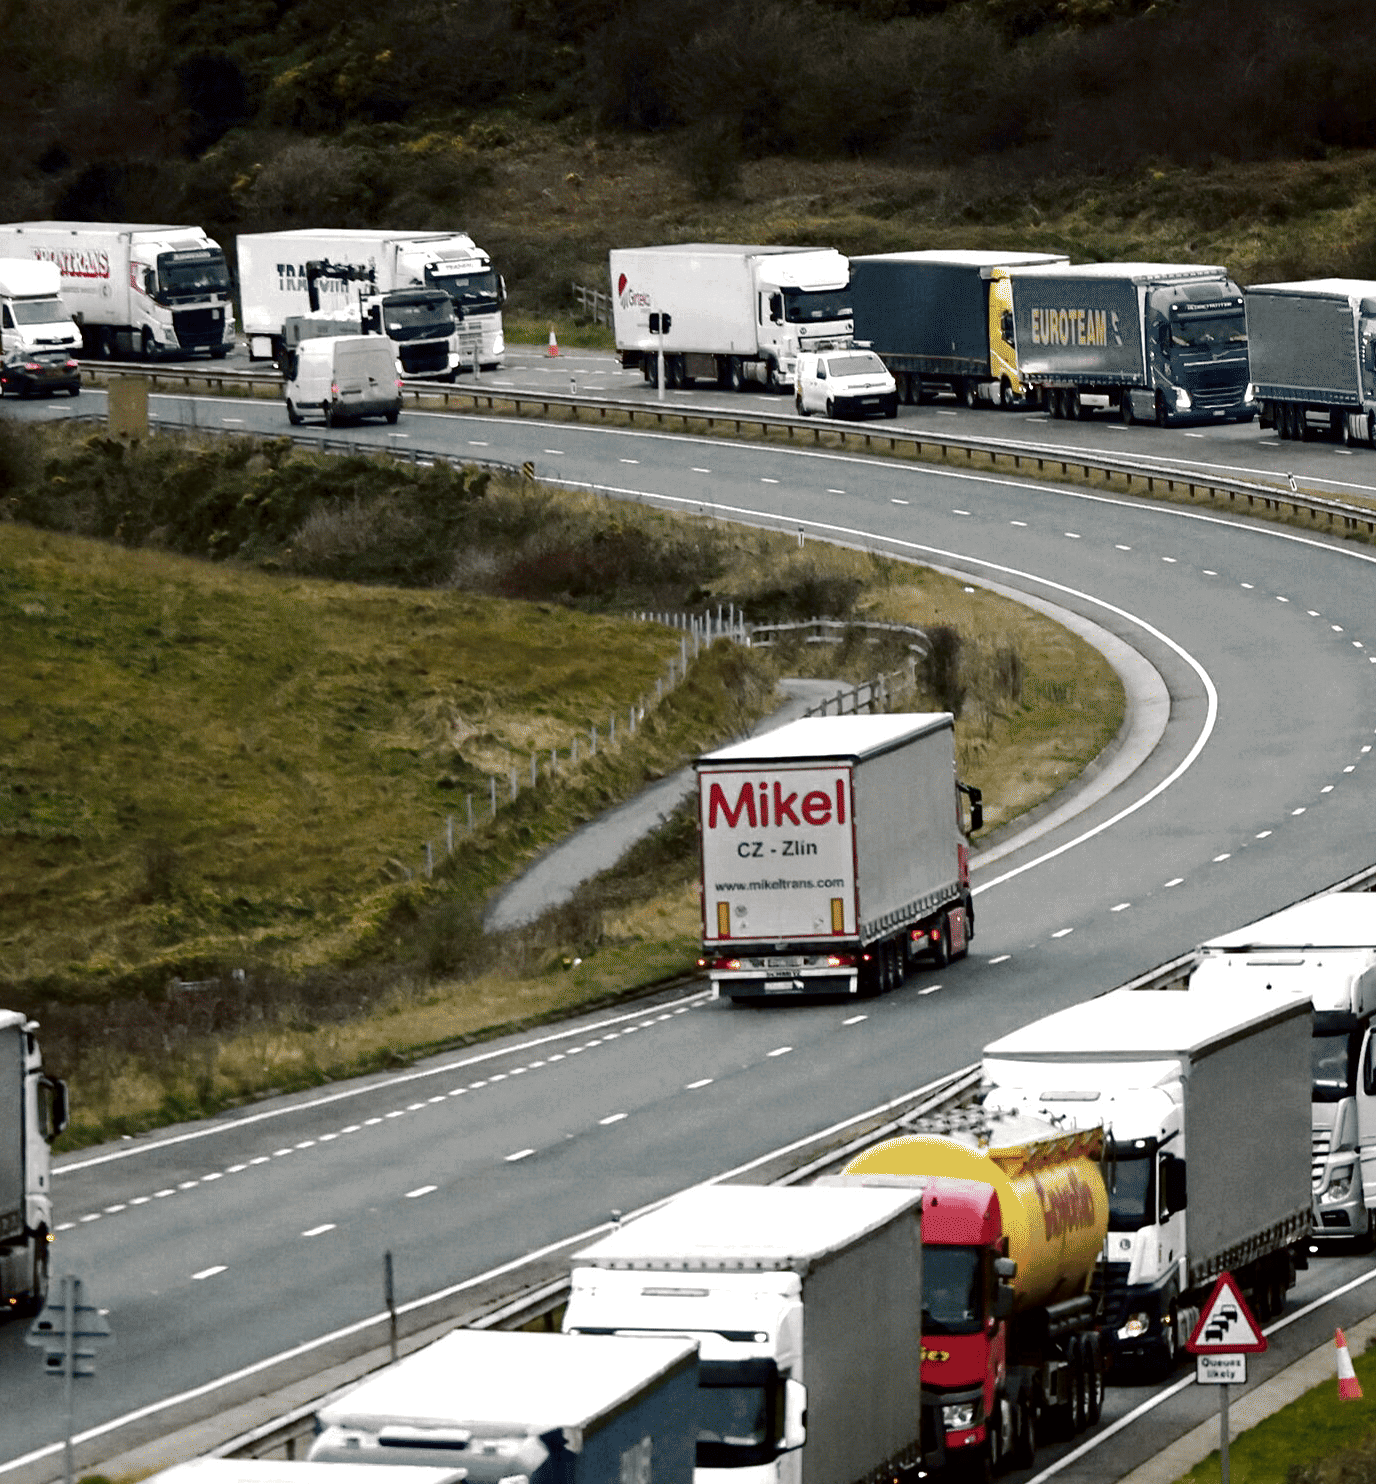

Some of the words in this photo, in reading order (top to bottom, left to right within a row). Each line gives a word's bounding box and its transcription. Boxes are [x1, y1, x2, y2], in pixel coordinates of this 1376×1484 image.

[1031, 308, 1108, 347] EUROTEAM
[708, 778, 846, 829] Mikel
[737, 841, 765, 859] CZ
[714, 878, 845, 892] www.mikeltrans.com
[1202, 1357, 1241, 1368] Queues
[1206, 1369, 1236, 1380] likely
